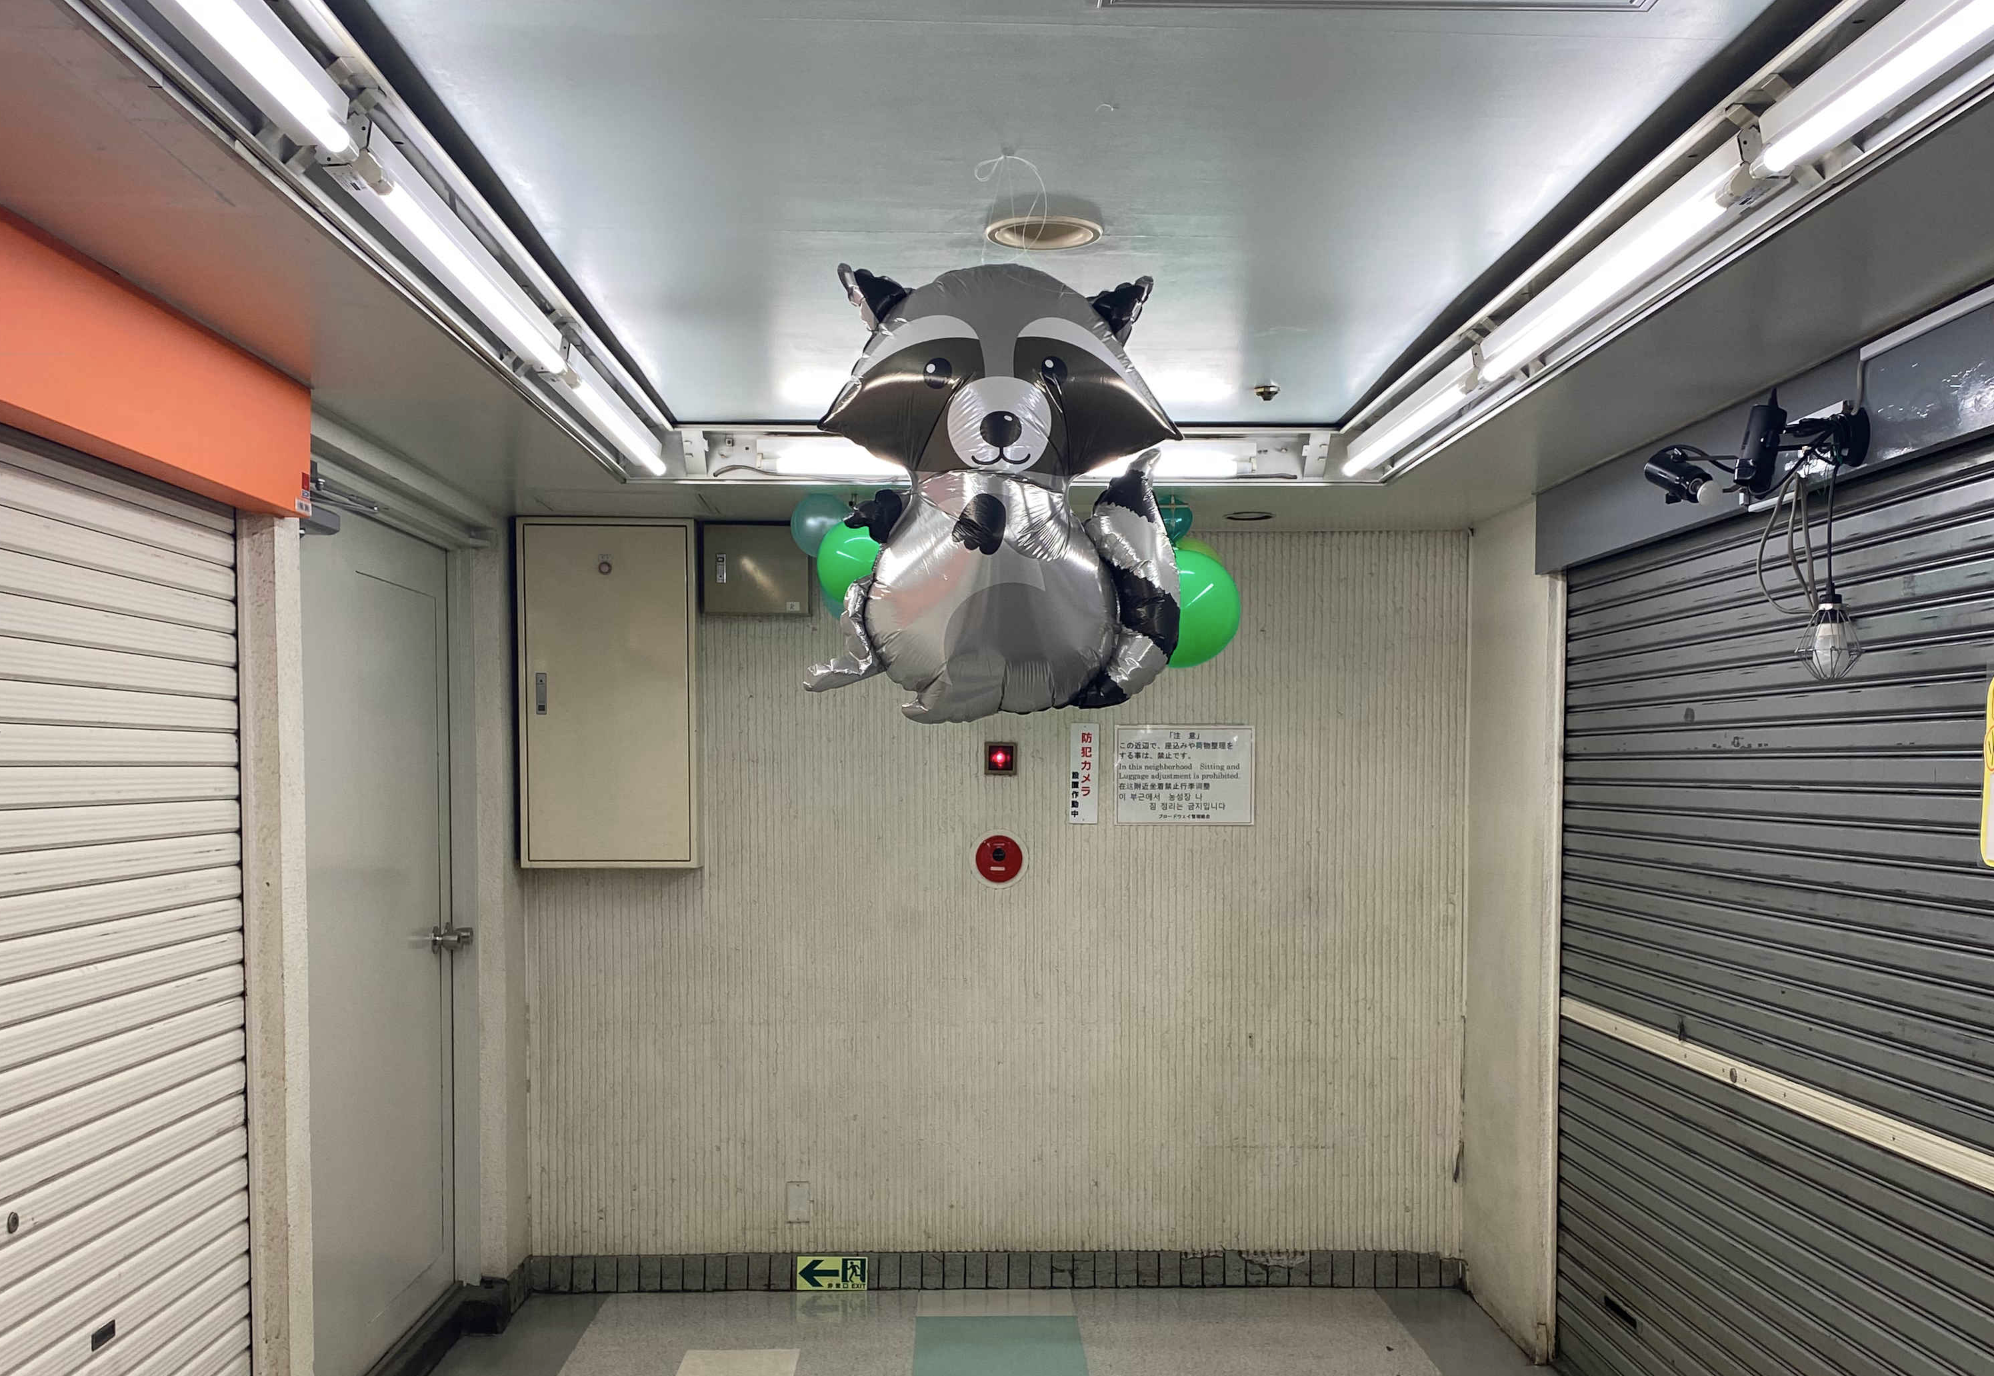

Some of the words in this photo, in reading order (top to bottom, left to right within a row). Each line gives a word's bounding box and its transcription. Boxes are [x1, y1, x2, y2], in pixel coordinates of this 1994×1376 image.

[1081, 732, 1092, 797] 防犯カメラ
[1144, 763, 1193, 771] neighborhood
[1199, 762, 1225, 771] Sitting
[1118, 772, 1149, 780] Luggage
[1150, 772, 1192, 780] adjustment
[1118, 793, 1126, 801] 이
[1188, 802, 1226, 811] 금지입니다
